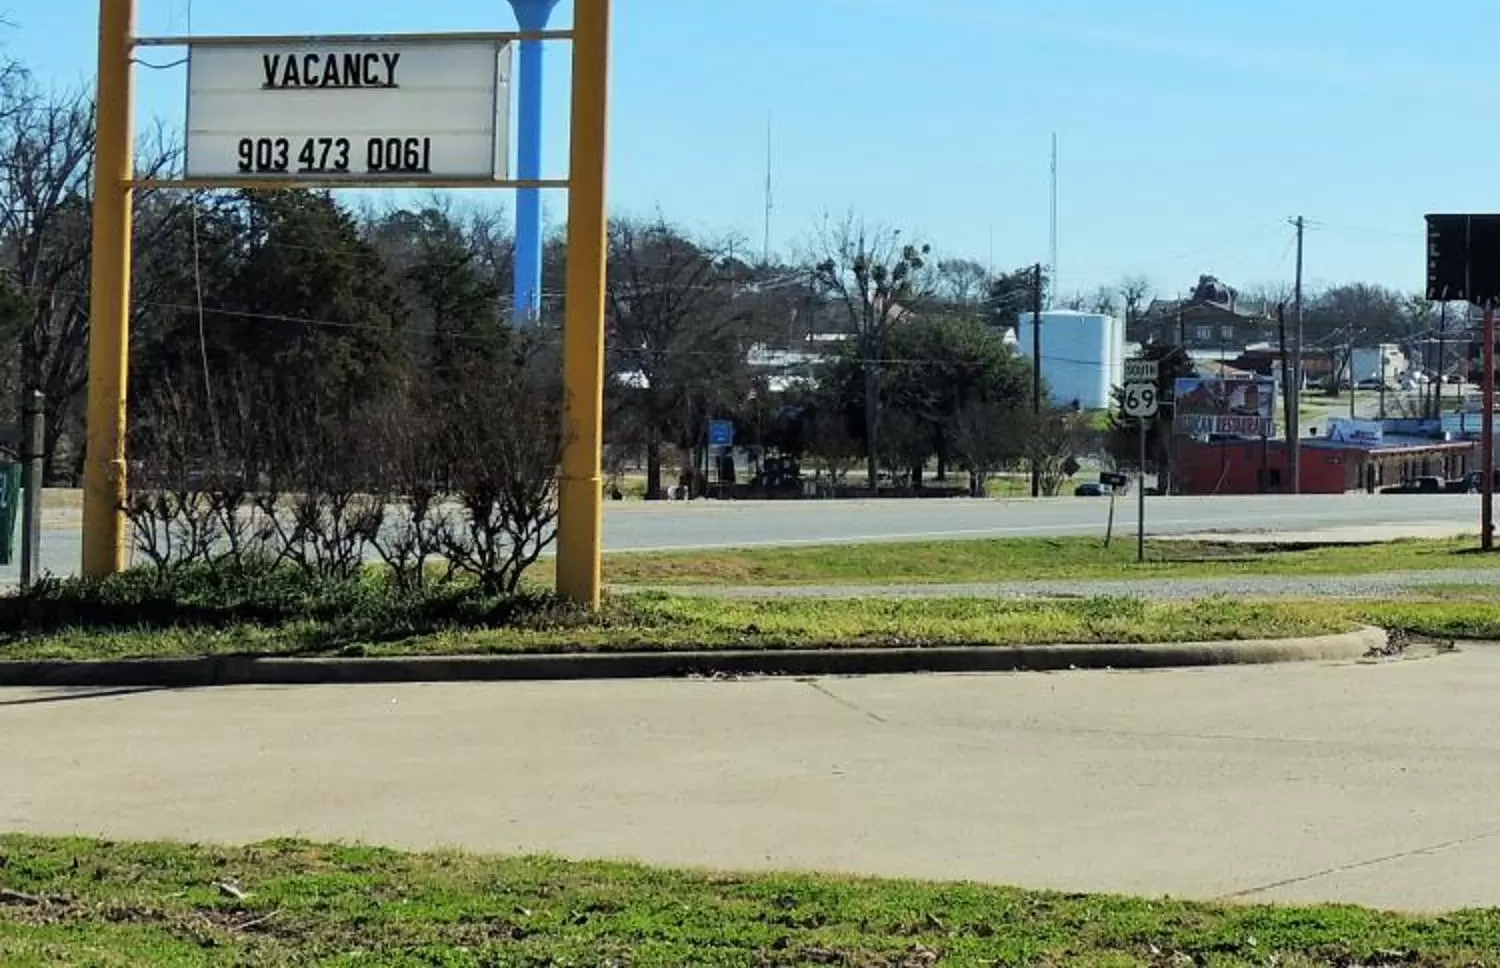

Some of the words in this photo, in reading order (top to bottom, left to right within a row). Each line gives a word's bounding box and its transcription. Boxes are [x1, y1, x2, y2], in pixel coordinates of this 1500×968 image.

[262, 53, 400, 87] VACANCY
[238, 137, 290, 172] 903
[298, 137, 351, 171] 473
[367, 137, 431, 171] 0061
[1126, 363, 1156, 377] SOUTH
[1127, 389, 1153, 410] 69
